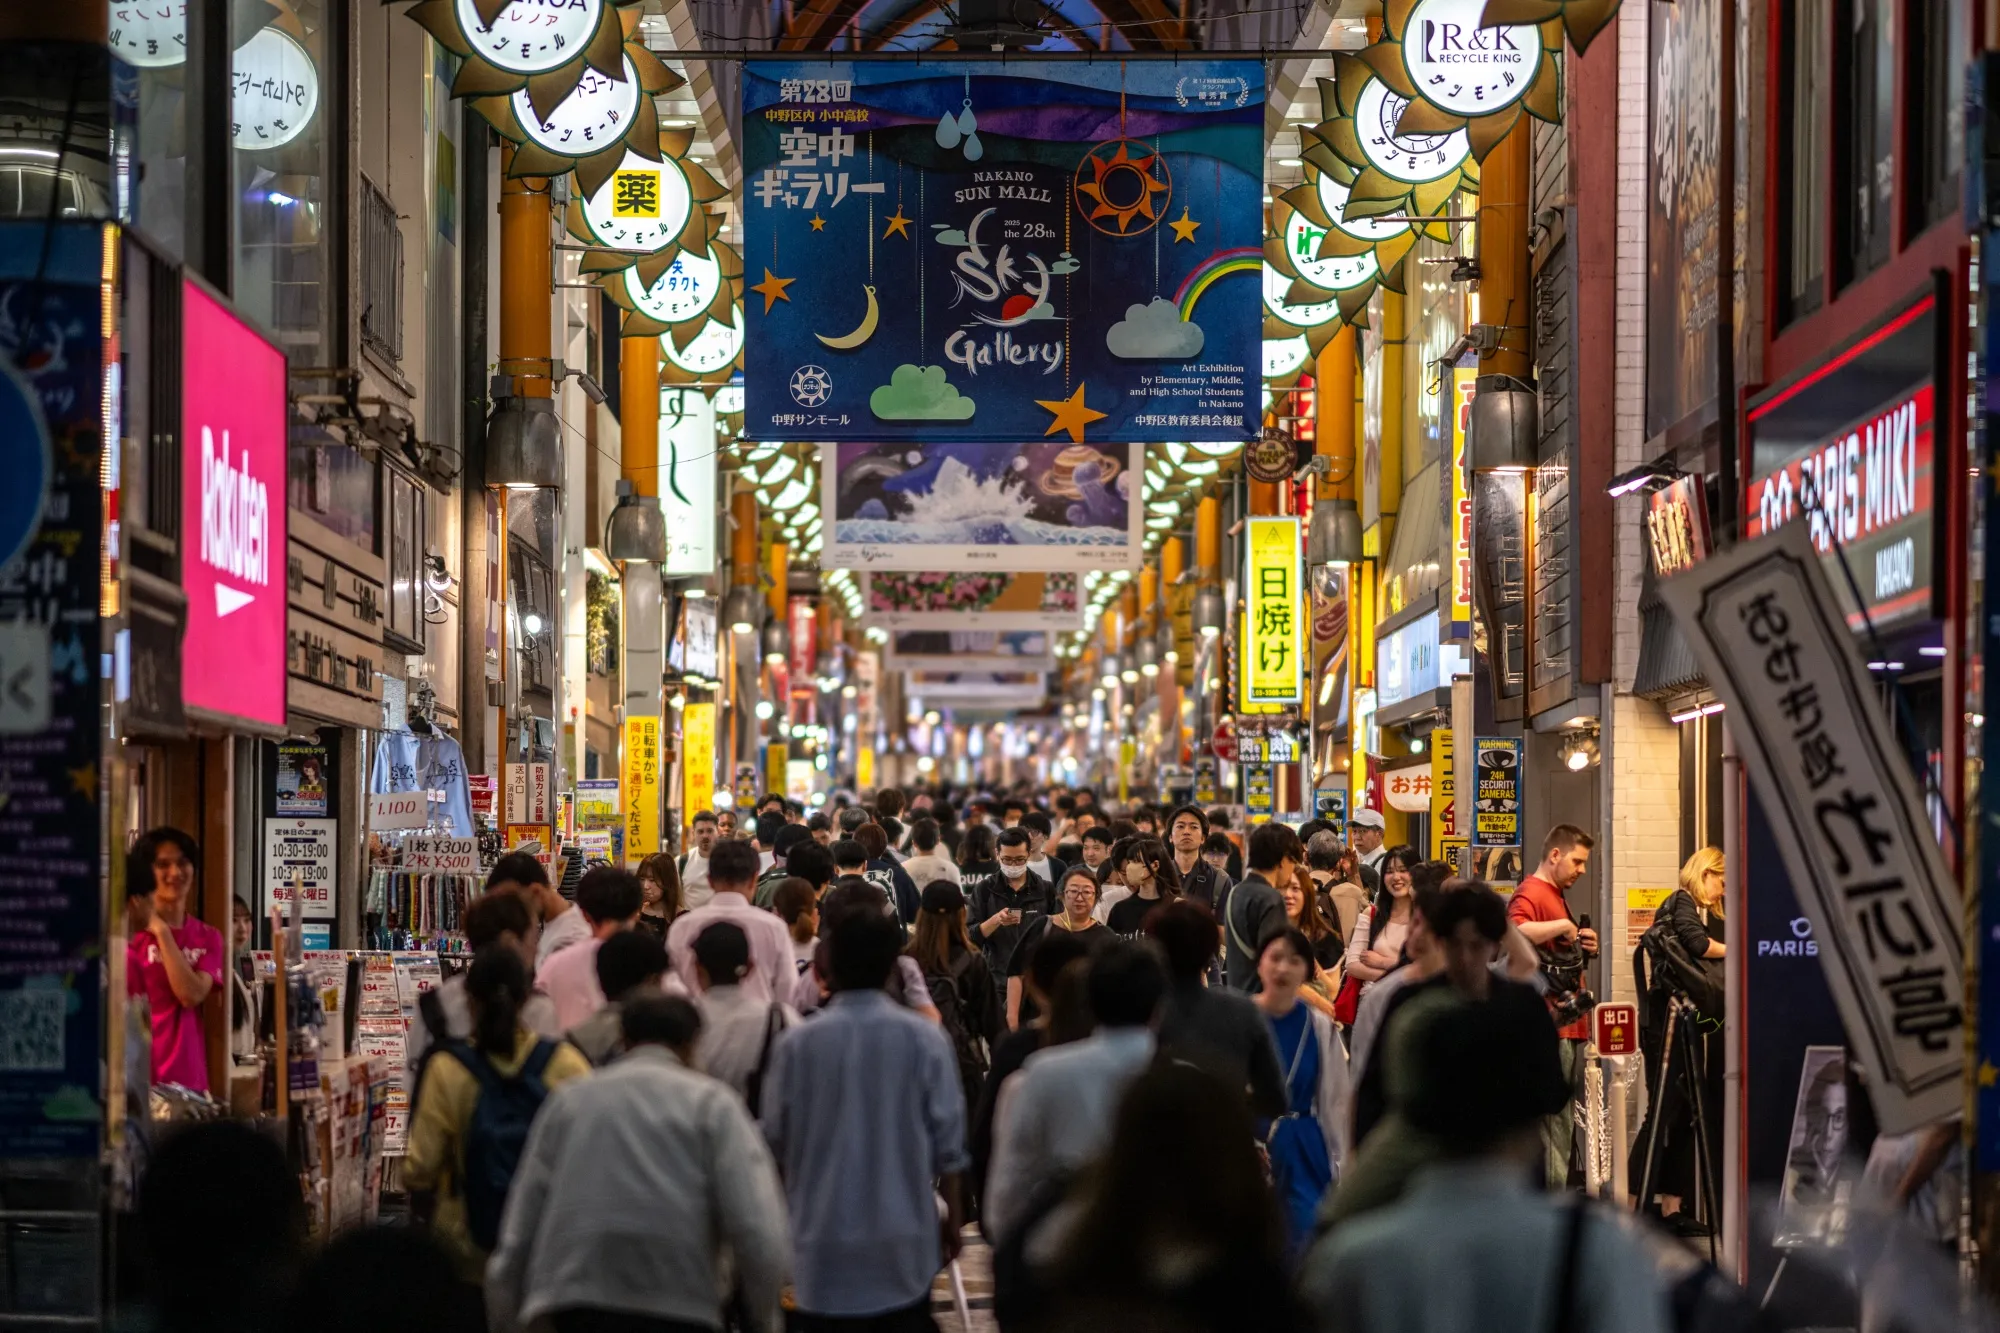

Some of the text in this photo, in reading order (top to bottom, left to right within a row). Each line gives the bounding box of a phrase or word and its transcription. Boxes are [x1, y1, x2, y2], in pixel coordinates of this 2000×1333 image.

[1440, 23, 1520, 51] R&K
[1439, 53, 1522, 64] RECYCLE KING
[779, 78, 851, 104] 第28回
[1428, 70, 1515, 101] サンモール
[765, 109, 869, 123] 中野区内 小中高校
[779, 126, 855, 167] 空中
[1371, 136, 1446, 170] サンモール
[973, 171, 1034, 183] NAKANO
[616, 173, 657, 214] 薬
[754, 169, 886, 209] ギャラリー
[954, 185, 1052, 204] SUN MALL
[600, 222, 669, 244] サンモール
[1004, 222, 1056, 238] the 28th
[944, 330, 1065, 376] Gallery
[1181, 364, 1244, 373] Art Exhibition
[1141, 376, 1244, 386] by Elementary, Middle,
[1129, 388, 1244, 398] and High School Students
[1198, 400, 1244, 408] in Nakano
[771, 414, 851, 426] 中野サンモール
[1135, 415, 1244, 427] 中野区教育委員会後援
[1801, 433, 1860, 552] PARIS
[1865, 400, 1917, 532] MIKI
[200, 424, 269, 587] Rakuten
[1875, 536, 1915, 600] NAKANO
[1256, 566, 1291, 673] 日焼け
[643, 721, 656, 785] 自転車から
[1478, 740, 1518, 750] WARNING!
[515, 765, 525, 794] 送水口
[1490, 771, 1505, 780] 24H
[629, 721, 642, 848] 降りてご通行ください
[1479, 780, 1516, 790] SECURITY
[535, 766, 544, 822] 防犯カメラ設置
[1479, 789, 1516, 799] CAMERAS
[1479, 815, 1514, 823] 防犯カメラ
[1484, 823, 1511, 831] 作動中!
[274, 828, 327, 836] 定休日のご案内
[514, 826, 543, 834] WARNING!
[520, 833, 539, 841] 警告!
[272, 843, 328, 858] 10:30-19:00
[409, 840, 472, 854] 1枚 ¥300
[405, 853, 470, 869] 2枚 ¥500
[1758, 940, 1819, 957] PARIS
[1604, 1009, 1629, 1025] 出口
[1610, 1043, 1625, 1051] EXIT
